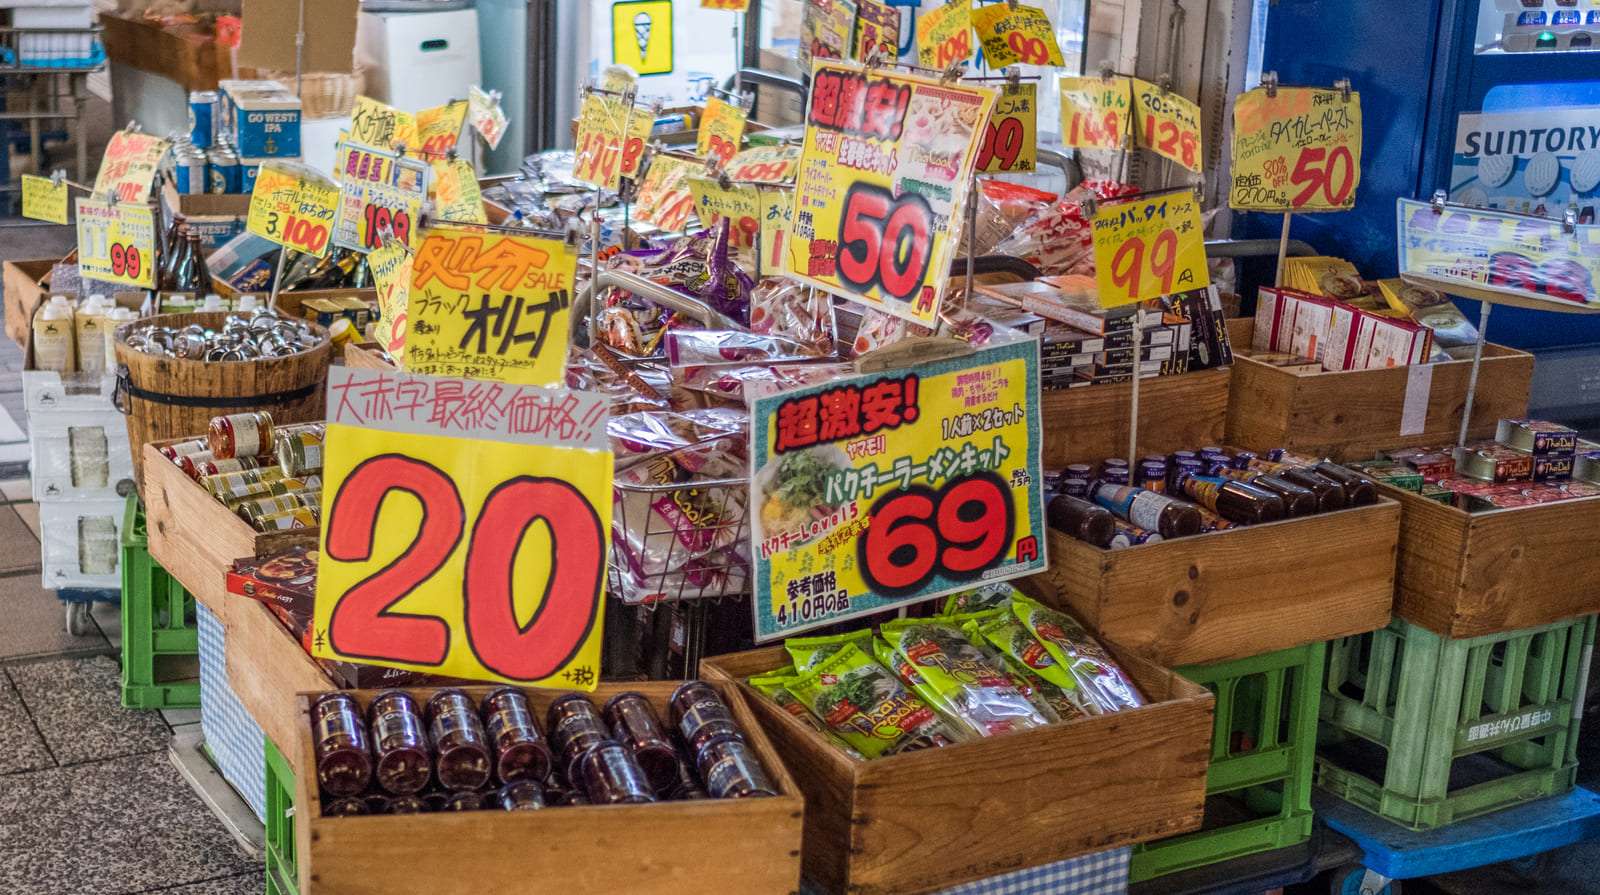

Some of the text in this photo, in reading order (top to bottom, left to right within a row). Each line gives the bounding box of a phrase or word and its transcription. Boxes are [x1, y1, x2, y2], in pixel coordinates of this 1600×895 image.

[1008, 31, 1049, 66] 99
[248, 112, 298, 123] GO WEST!
[264, 124, 282, 133] IPA
[1144, 114, 1197, 168] 128
[1263, 156, 1287, 180] 80%
[1290, 146, 1354, 208] 50
[299, 202, 336, 221] はちみつ
[283, 215, 328, 252] 100
[839, 183, 934, 303] 50
[111, 243, 141, 279] 99
[413, 235, 549, 291] 処分
[1111, 228, 1178, 298] 99
[523, 271, 565, 290] SALE
[415, 287, 470, 316] ブラック
[459, 289, 569, 359] オリーブ
[776, 375, 920, 453] 超激安!
[847, 434, 886, 460] ヤマモリ
[824, 436, 1010, 504] パクチーラーメンキット
[1009, 475, 1031, 489] 75円
[858, 472, 1014, 596] 69
[1016, 535, 1038, 563] 円
[315, 629, 325, 652] ¥
[325, 453, 606, 682] 20
[562, 667, 594, 686] +税
[786, 571, 836, 601] 参考価格
[777, 588, 850, 626] 410円の品
